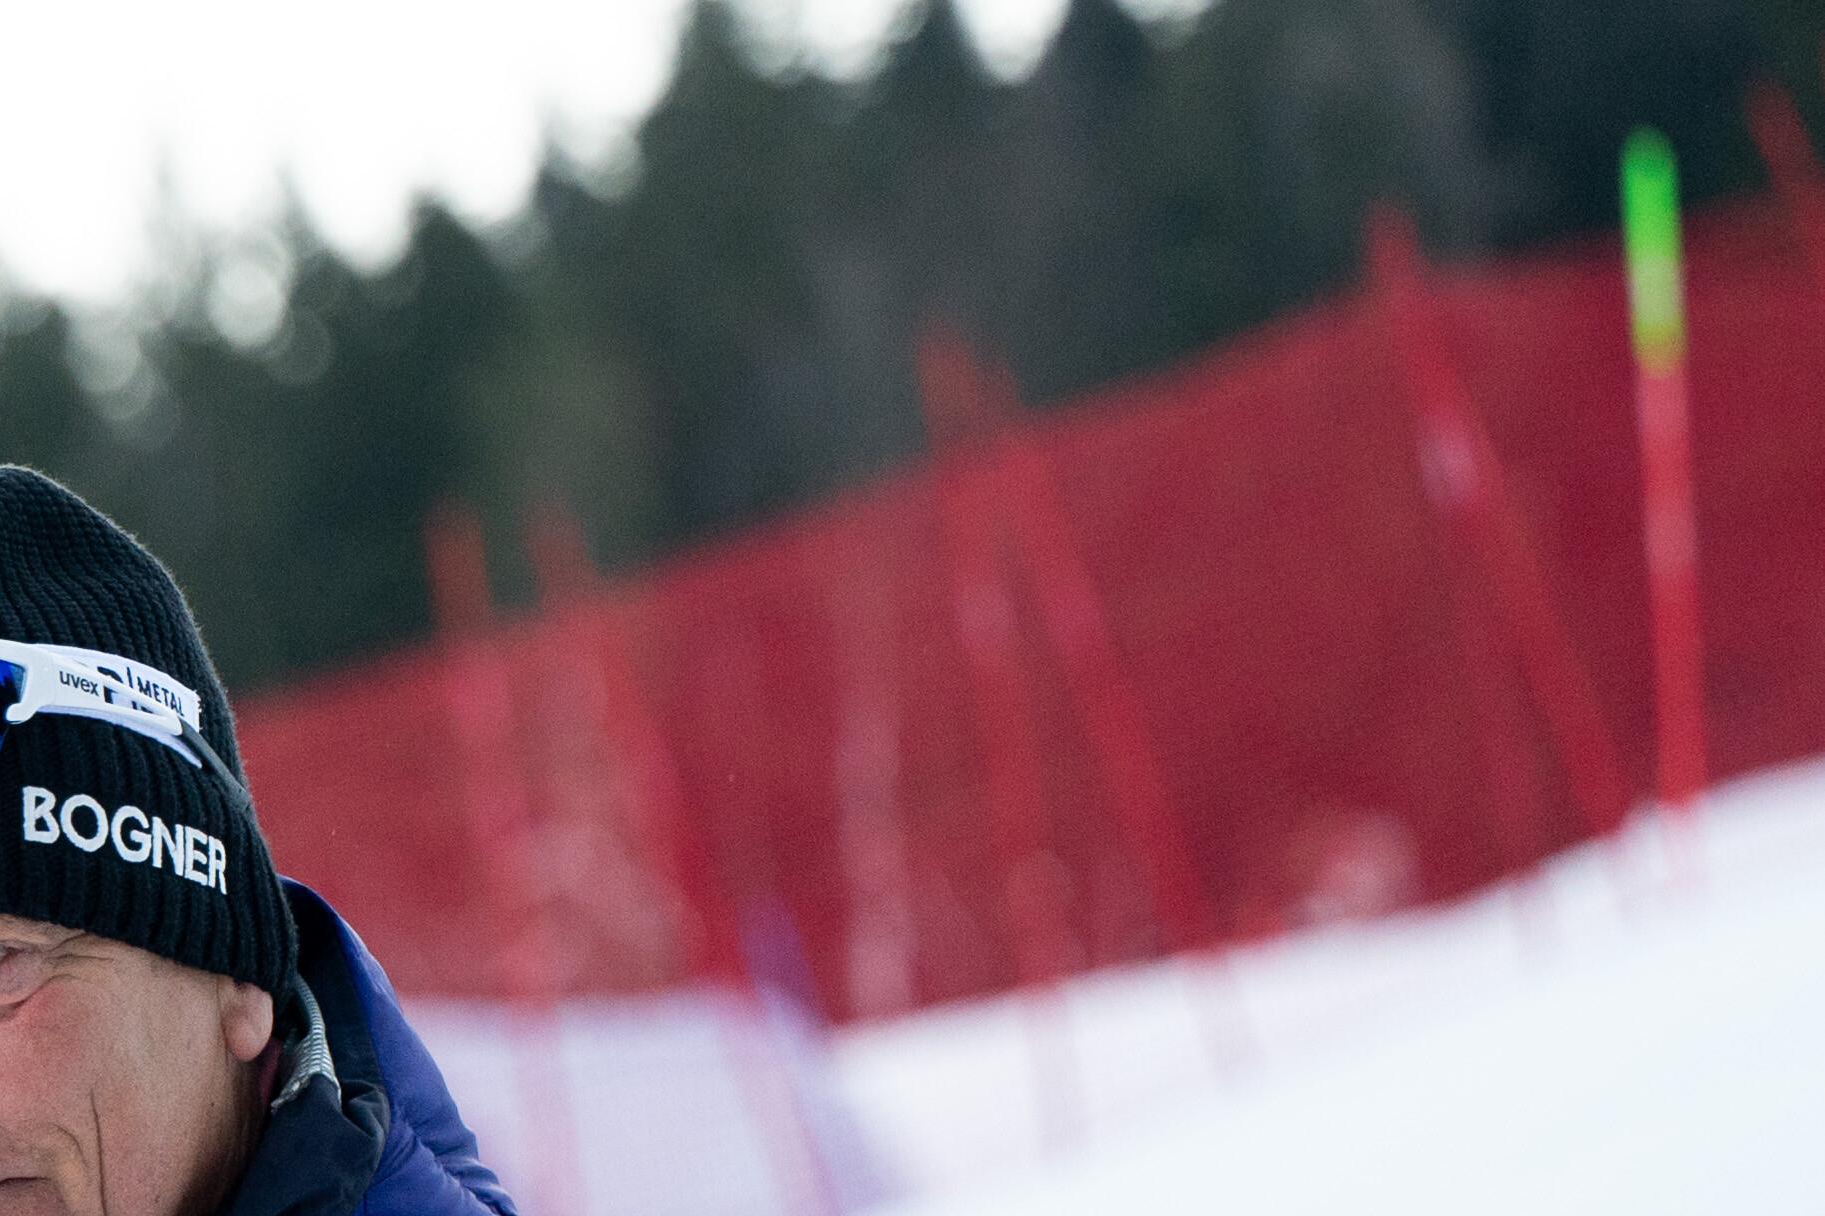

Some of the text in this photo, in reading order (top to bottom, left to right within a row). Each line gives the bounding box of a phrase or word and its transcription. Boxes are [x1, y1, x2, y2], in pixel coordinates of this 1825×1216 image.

[59, 670, 100, 697] uvex
[137, 675, 185, 717] METAL
[22, 785, 227, 894] BOGNER
